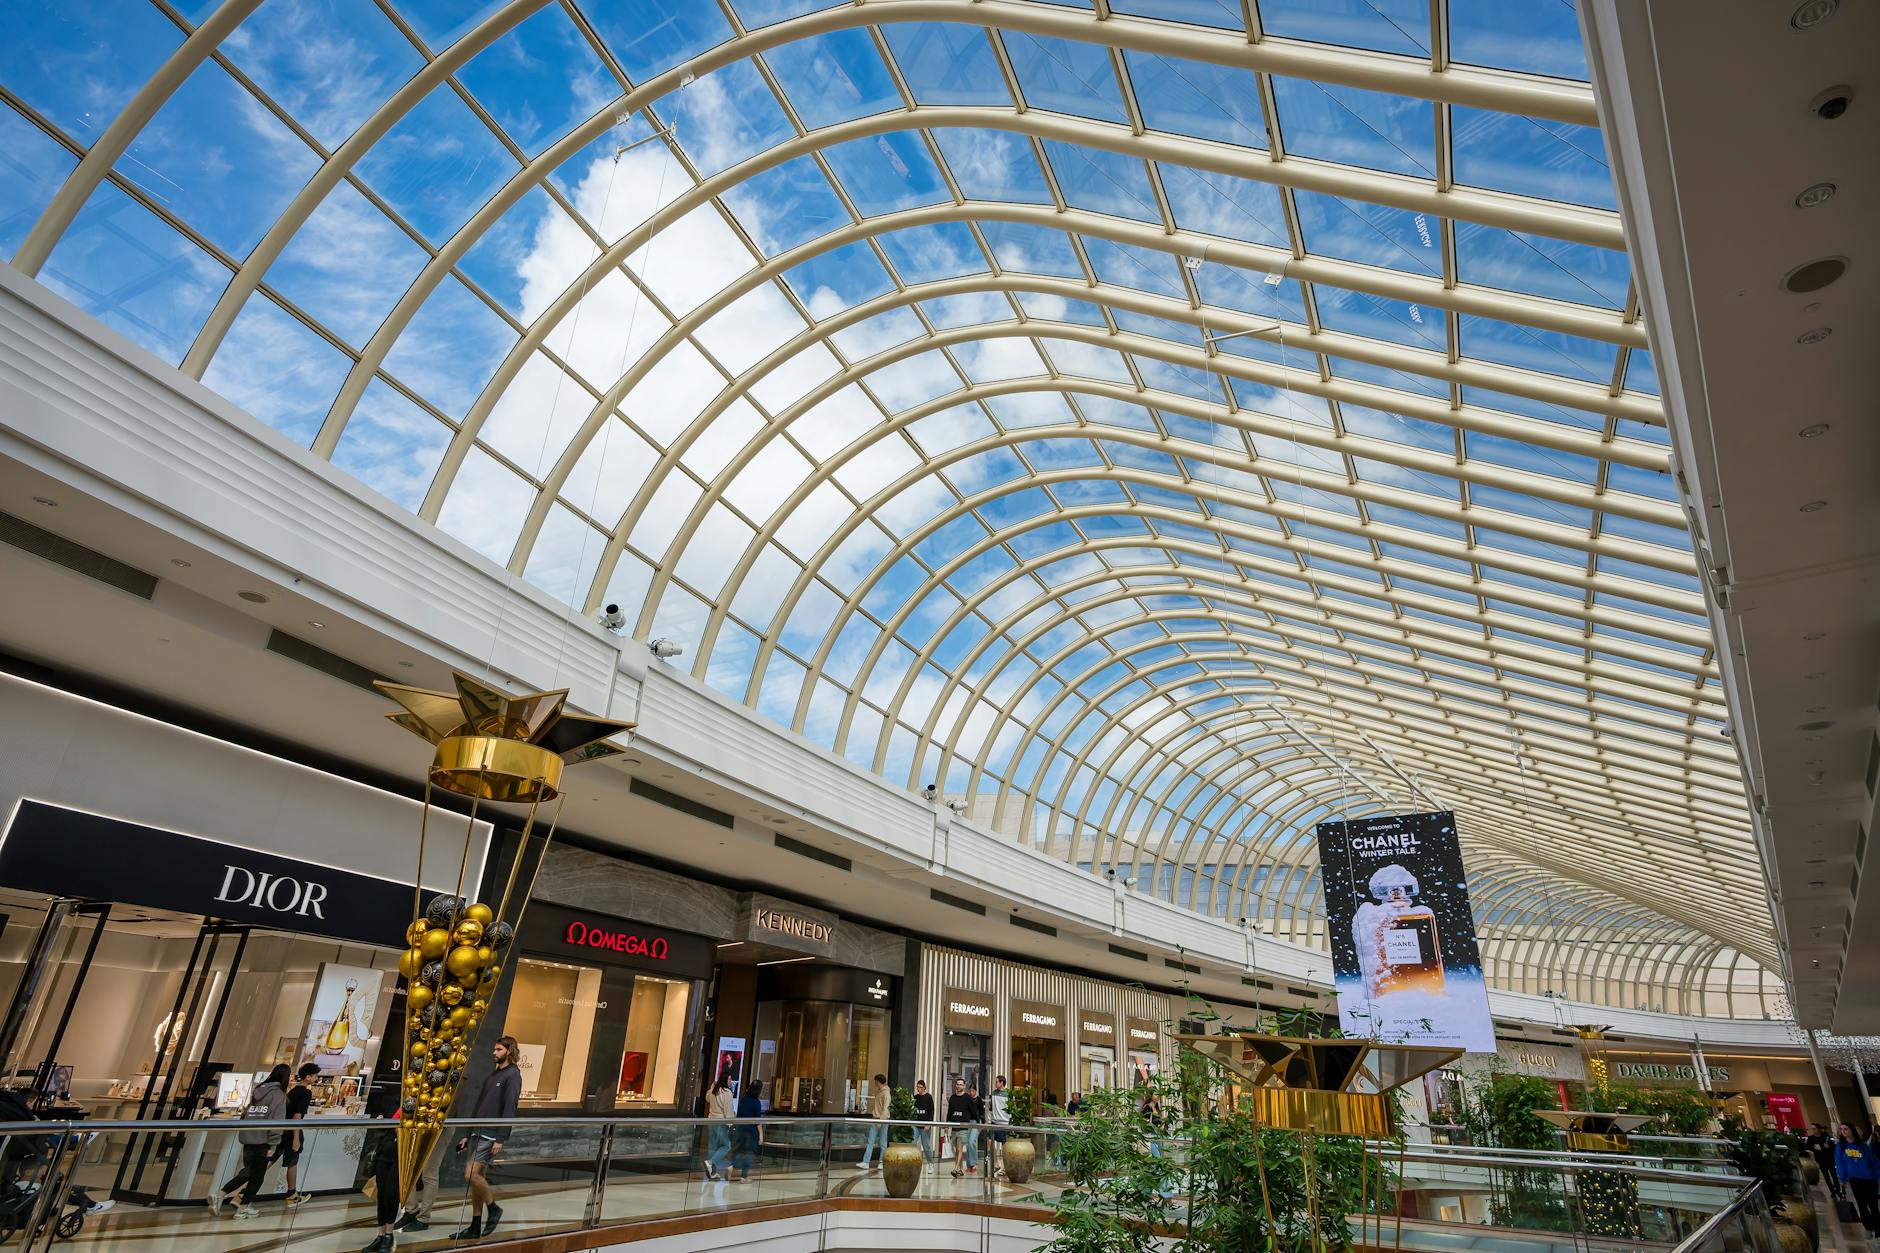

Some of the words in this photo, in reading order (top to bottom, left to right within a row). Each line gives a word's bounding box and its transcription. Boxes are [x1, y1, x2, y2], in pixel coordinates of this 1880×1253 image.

[1352, 832, 1421, 850] CHANEL
[1359, 849, 1393, 858] WINTER
[1394, 847, 1416, 855] TALE
[213, 864, 328, 920] DIOR
[756, 909, 834, 943] KENNEDY
[589, 928, 649, 956] OMEGA
[950, 1002, 990, 1017] FERRAGAMO
[1022, 1012, 1056, 1026] FERRAGAMO
[1083, 1021, 1113, 1034] FERRAGAMO
[1130, 1028, 1156, 1040] FERRAGAMO
[1518, 1053, 1557, 1068] GUCCI
[1617, 1063, 1670, 1080] DAVID
[1674, 1064, 1730, 1081] JOES
